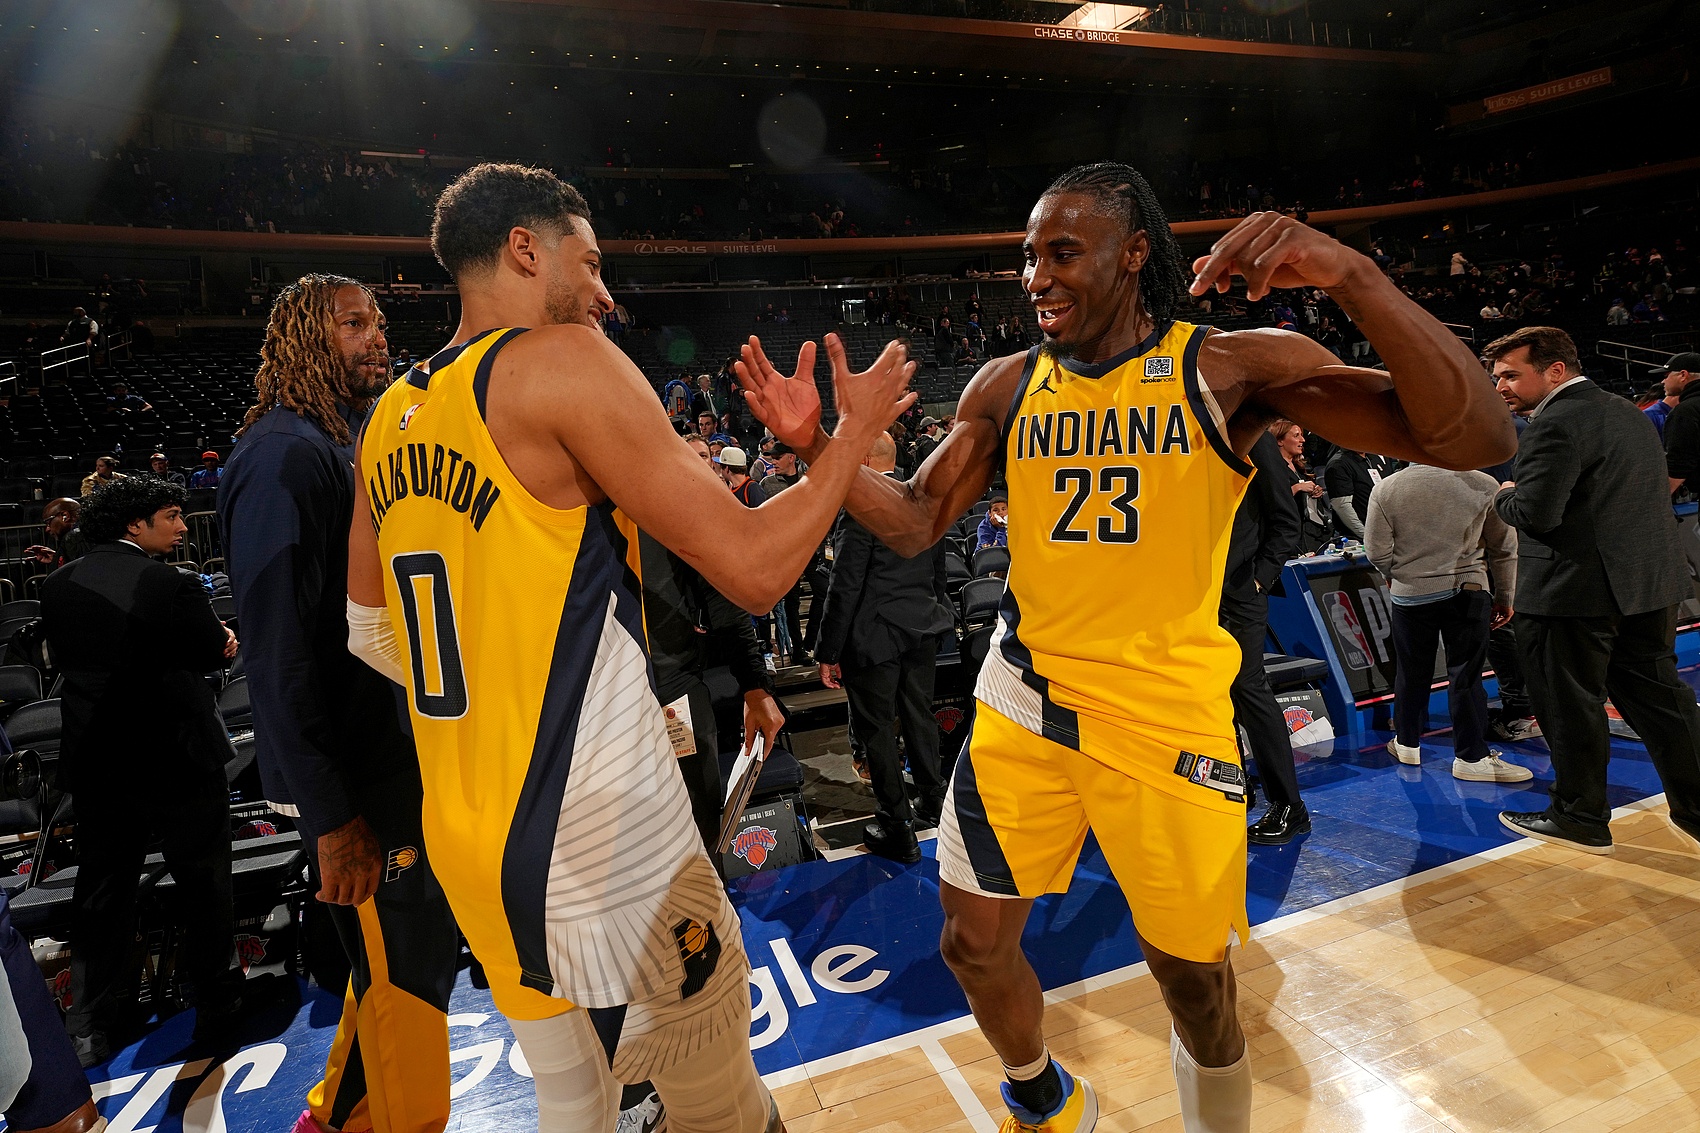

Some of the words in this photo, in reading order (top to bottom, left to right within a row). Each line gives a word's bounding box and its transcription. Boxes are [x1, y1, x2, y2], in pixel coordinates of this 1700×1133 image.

[1034, 27, 1073, 39] CHASE
[1087, 31, 1119, 42] BRIDGE
[1487, 93, 1525, 109] Infosys
[1530, 84, 1565, 99] SUITE
[1568, 73, 1607, 89] LEVEL
[654, 246, 707, 254] LEXUS
[723, 245, 749, 254] SUITE
[751, 245, 778, 253] LEVEL
[1017, 403, 1191, 460] INDIANA
[1049, 465, 1140, 544] 23
[390, 550, 470, 720] 0
[735, 829, 776, 854] KNICKS
